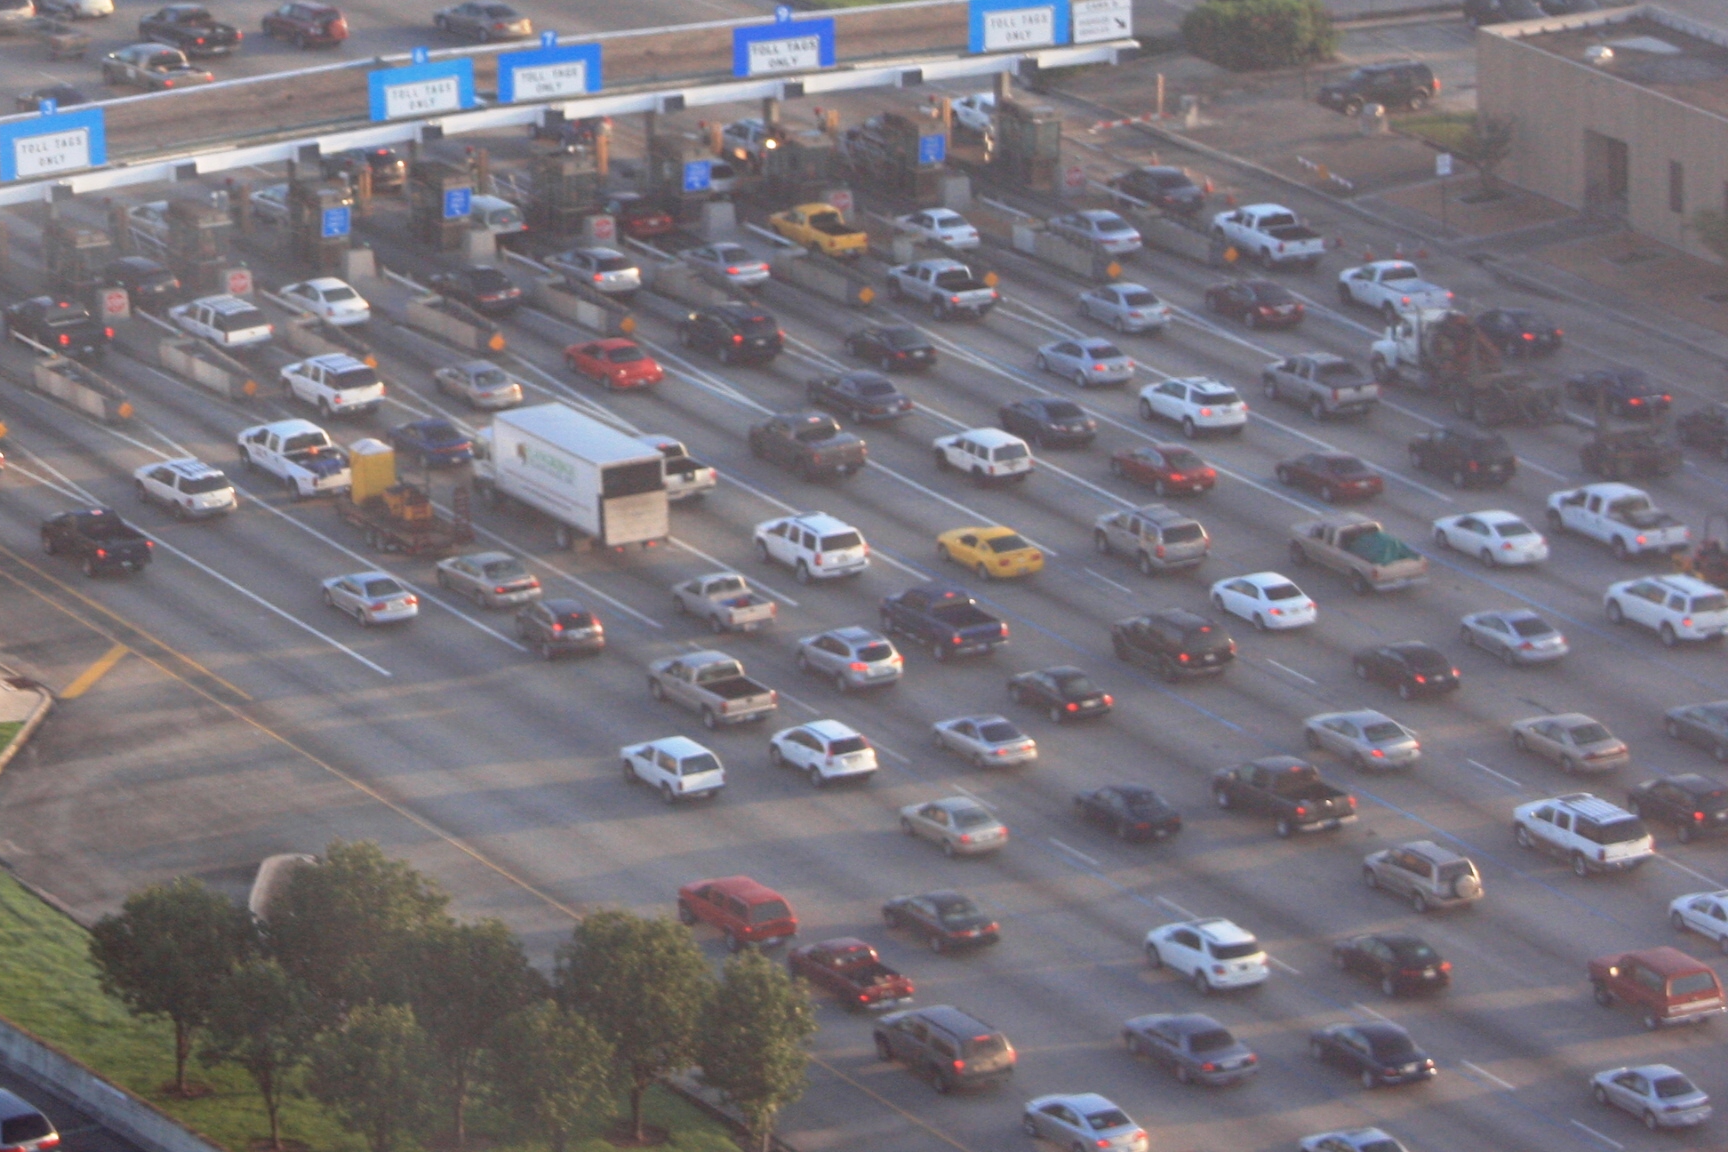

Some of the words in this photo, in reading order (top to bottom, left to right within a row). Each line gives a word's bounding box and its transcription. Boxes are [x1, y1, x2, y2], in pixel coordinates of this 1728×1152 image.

[989, 18, 1016, 29] TOLL
[1022, 13, 1048, 25] TAGS
[1005, 29, 1032, 42] ONLY
[752, 45, 778, 56] TOLL
[788, 39, 817, 51] TAGS
[768, 57, 797, 68] ONLY
[521, 71, 544, 82] TOLL
[393, 89, 418, 99] TOLL
[425, 82, 451, 94] TAGS
[535, 81, 562, 93] ONLY
[44, 100, 54, 116] 3
[410, 98, 435, 110] ONLY
[22, 143, 48, 154] TOLL
[55, 136, 83, 148] TAGS
[39, 154, 65, 167] ONLY
